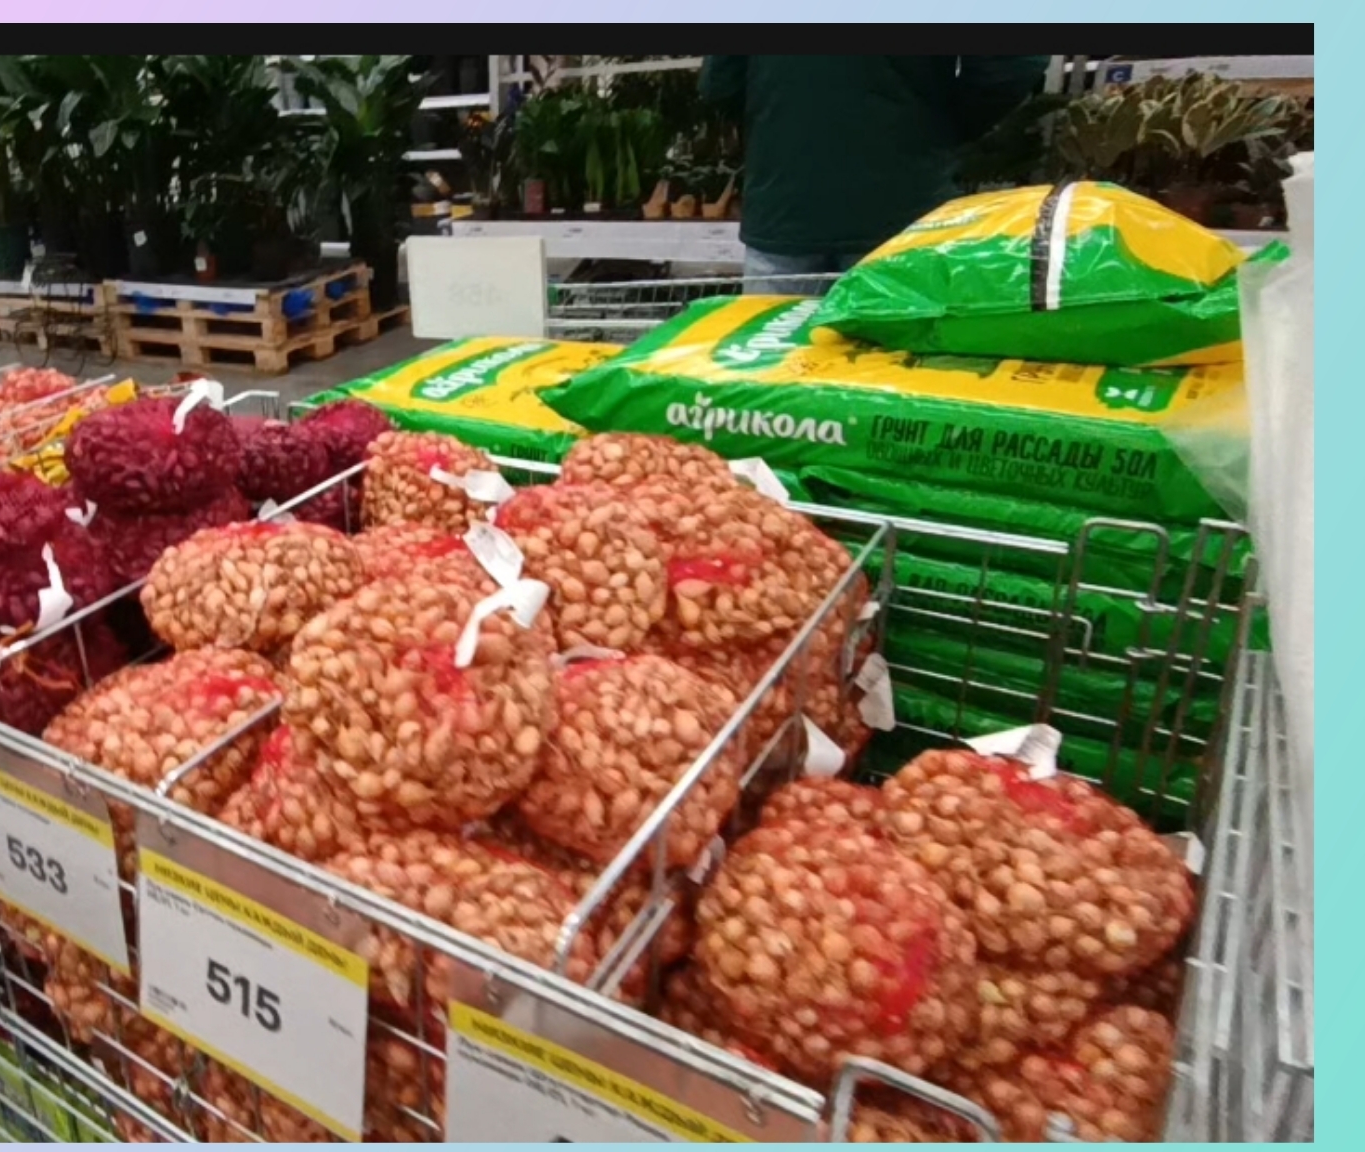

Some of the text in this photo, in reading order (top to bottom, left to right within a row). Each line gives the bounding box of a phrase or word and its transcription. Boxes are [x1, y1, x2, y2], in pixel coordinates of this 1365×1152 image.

[871, 415, 929, 444] ГРУНТ
[937, 423, 985, 450] ДЛЯ
[991, 431, 1105, 469] РАССАДЫ
[6, 833, 68, 895] 533
[206, 957, 282, 1033] 515
